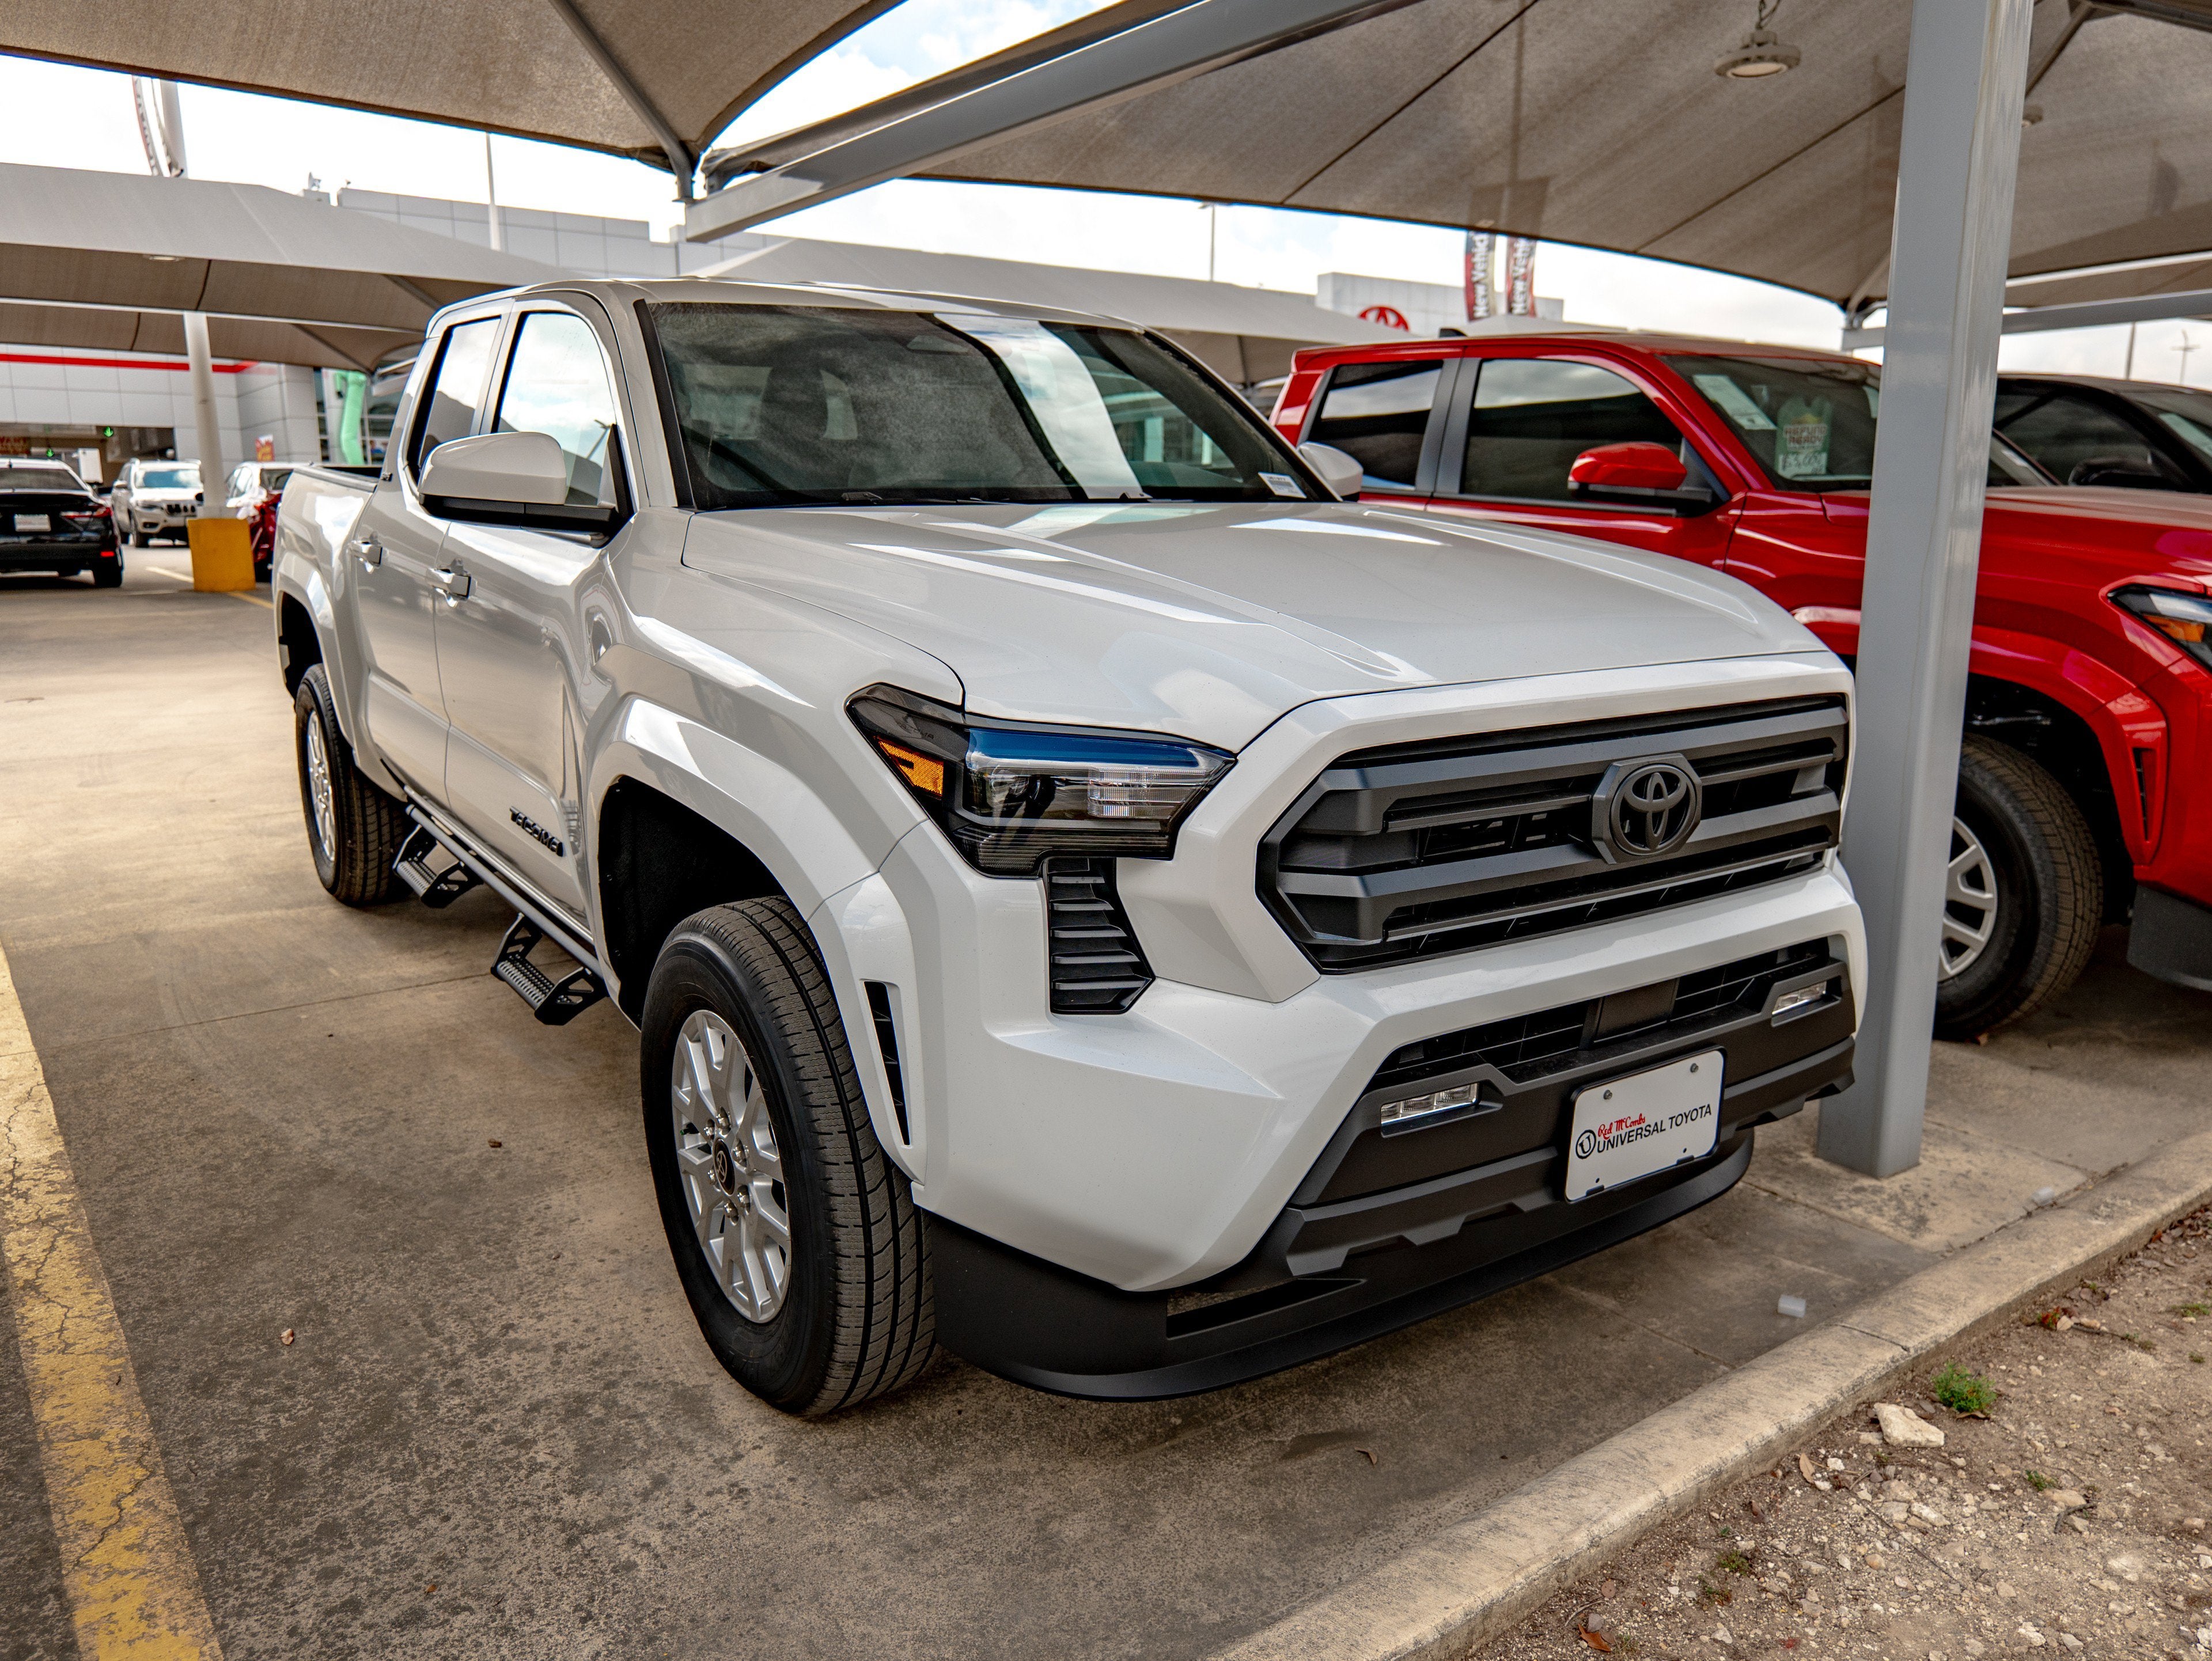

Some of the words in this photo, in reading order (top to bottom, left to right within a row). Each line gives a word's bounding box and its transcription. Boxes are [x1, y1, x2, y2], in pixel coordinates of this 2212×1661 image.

[1471, 233, 1489, 282] Vehicl
[1473, 283, 1489, 317] New
[1511, 279, 1528, 315] New
[510, 807, 564, 857] TACOMA
[1597, 1119, 1666, 1153] UNIVERSAL
[1668, 1103, 1711, 1129] TOYOTA
[1598, 1122, 1613, 1140] Red
[1614, 1113, 1646, 1132] McCombs
